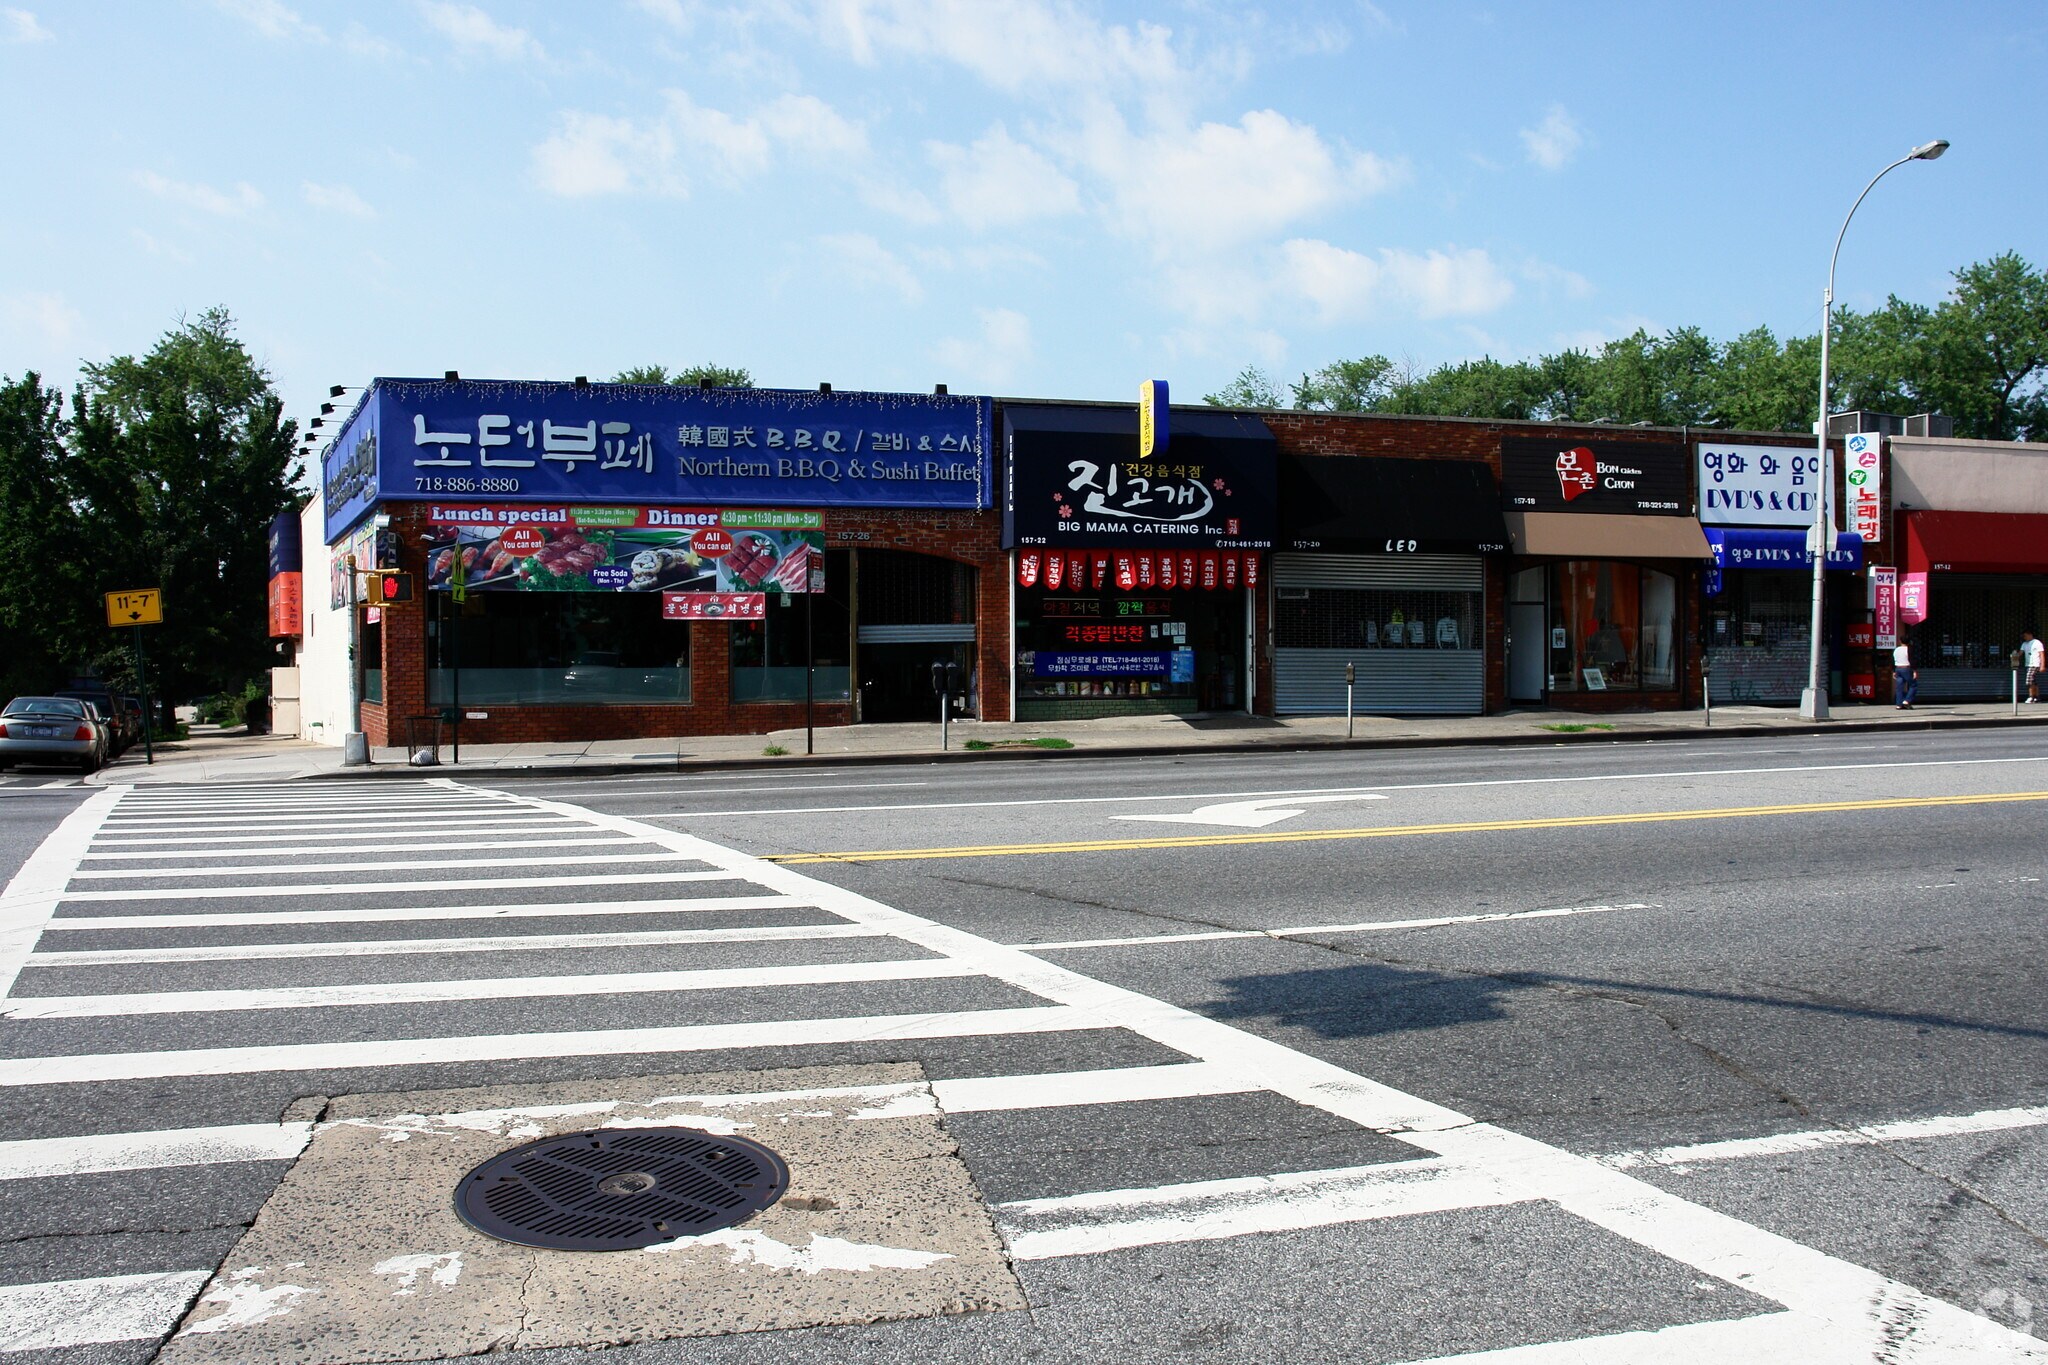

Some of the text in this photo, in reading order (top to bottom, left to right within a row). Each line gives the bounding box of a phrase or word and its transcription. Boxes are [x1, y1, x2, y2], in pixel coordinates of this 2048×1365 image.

[677, 424, 757, 448] 韓國式
[766, 428, 847, 452] B.B.Q.
[871, 431, 911, 452] 갈비
[918, 436, 934, 453] &
[678, 456, 981, 482] Northern B.B.Q. & Sushi Buffet
[1556, 451, 1595, 490] 본촌
[1704, 452, 1749, 483] 영화
[1760, 455, 1780, 475] 와
[414, 476, 519, 492] 718-886-8880
[1068, 459, 1214, 521] 진고개
[1707, 489, 1764, 510] DVD'S
[1769, 490, 1783, 511] &
[431, 506, 567, 525] Lunch special
[648, 509, 718, 526] Dinner
[721, 512, 736, 524] 4:30
[737, 515, 748, 526] pm
[753, 512, 769, 525] 11:30
[769, 516, 783, 527] pm
[783, 512, 799, 527] (Mon
[1856, 487, 1878, 541] 노래방
[514, 530, 530, 539] All
[1058, 521, 1226, 535] BIG MAMA CATERING Inc.
[705, 532, 720, 541] All
[837, 532, 871, 541] 157-26
[502, 540, 542, 549] You can eat
[693, 542, 707, 550] You
[720, 542, 732, 550] eat
[1293, 540, 1320, 549] 157-20
[1386, 539, 1417, 552] LEO
[1478, 543, 1504, 551] 157-20
[1732, 548, 1753, 563] 영화
[1755, 548, 1791, 560] DVD'S
[593, 568, 628, 578] Free Soda
[1876, 574, 1894, 585] 여성
[1879, 587, 1891, 635] 우리사우나
[1849, 632, 1870, 644] 노래방
[1849, 683, 1871, 695] 노래방
